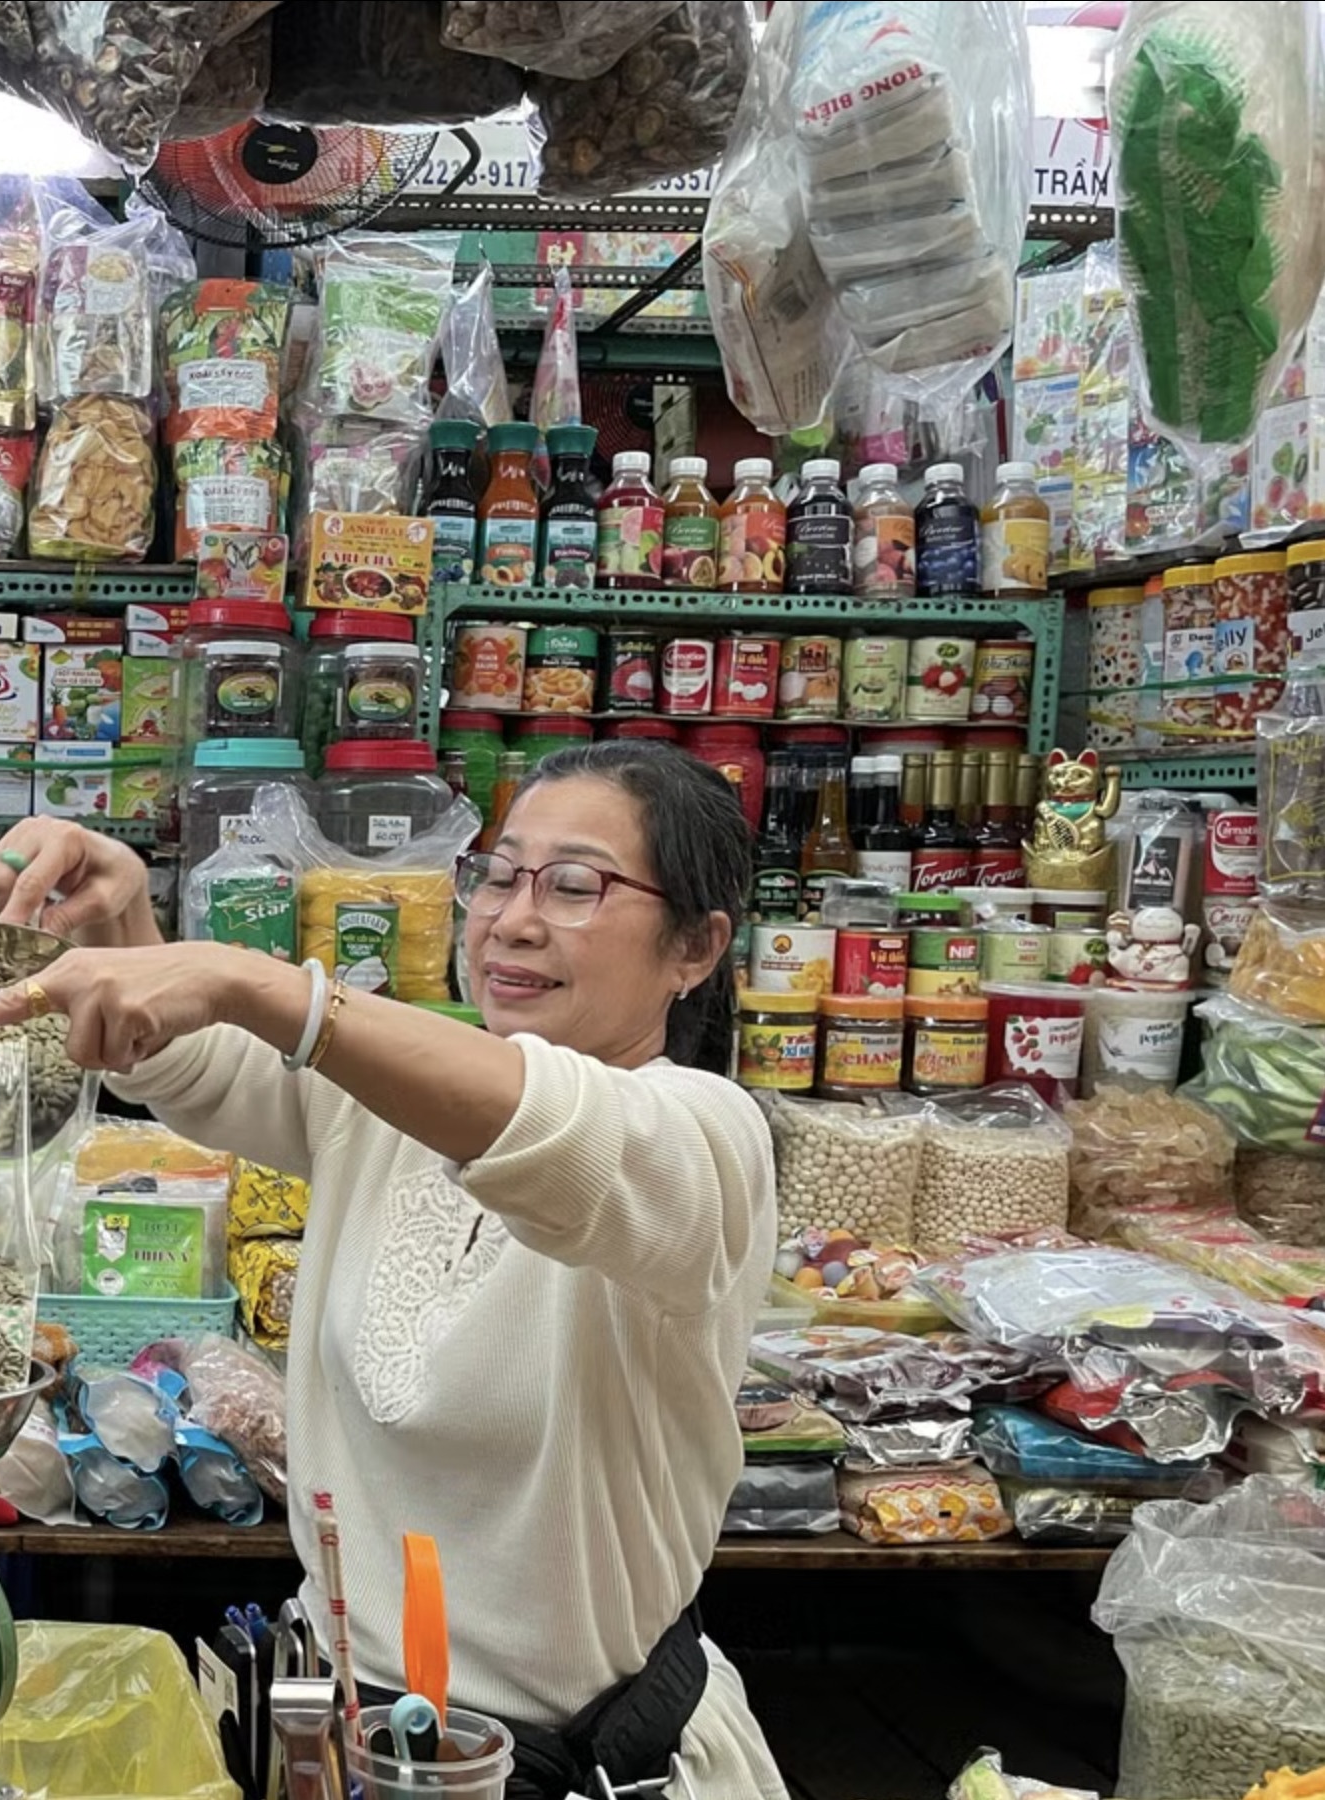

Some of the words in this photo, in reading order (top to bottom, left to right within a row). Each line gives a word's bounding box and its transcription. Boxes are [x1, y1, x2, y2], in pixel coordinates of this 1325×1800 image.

[860, 62, 923, 100] RONG
[1034, 157, 1108, 196] TRẦN
[912, 861, 970, 893] Torani
[973, 861, 1025, 890] Toran
